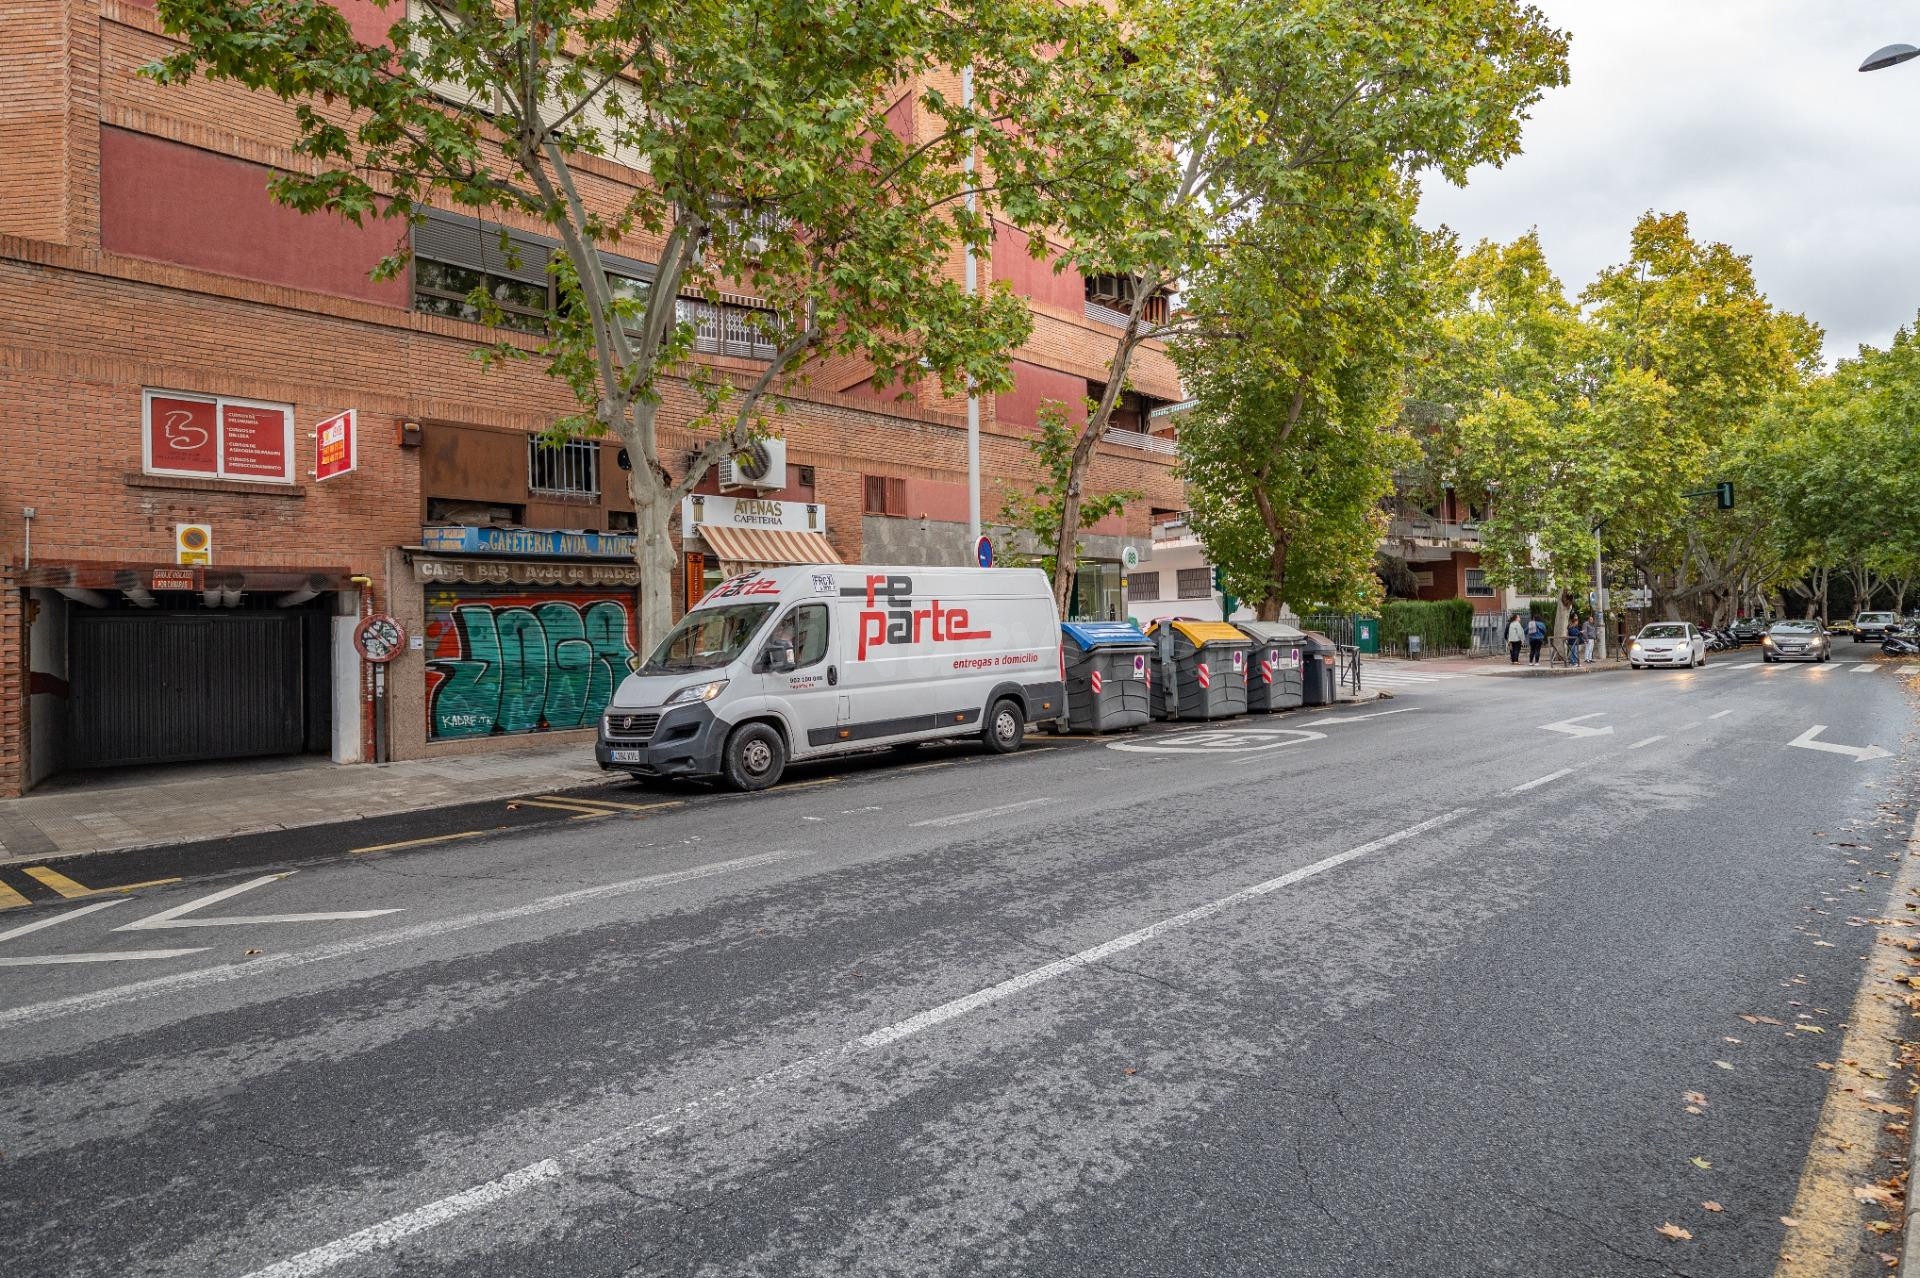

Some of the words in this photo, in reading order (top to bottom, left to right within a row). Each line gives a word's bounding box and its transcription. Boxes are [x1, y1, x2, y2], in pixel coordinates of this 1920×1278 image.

[734, 499, 783, 517] ATENAS
[734, 514, 783, 526] CAFETERIA
[489, 530, 554, 553] CAFETERIA
[598, 536, 637, 556] MADRI
[478, 564, 509, 578] BAR
[526, 566, 562, 578] Avda
[568, 567, 584, 578] de
[592, 567, 640, 579] MADRI
[703, 578, 781, 606] parte
[840, 575, 912, 608] re
[857, 599, 992, 661] parte
[953, 658, 992, 670] entregas
[994, 658, 1000, 666] a
[1002, 652, 1038, 665] domicilio
